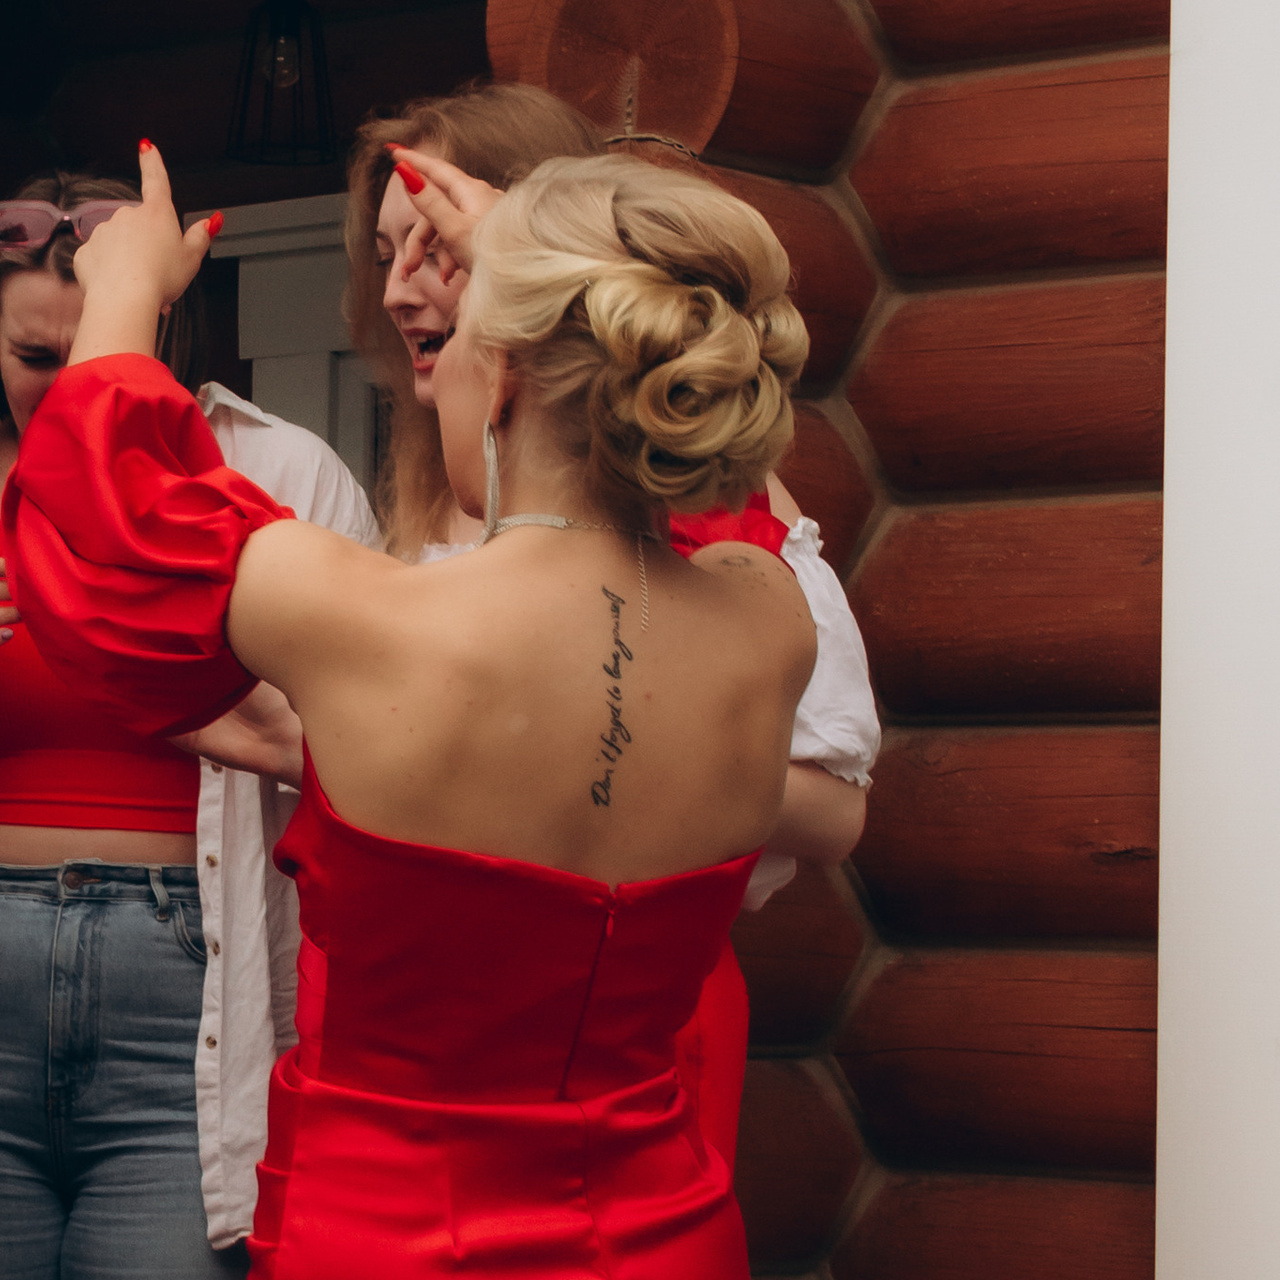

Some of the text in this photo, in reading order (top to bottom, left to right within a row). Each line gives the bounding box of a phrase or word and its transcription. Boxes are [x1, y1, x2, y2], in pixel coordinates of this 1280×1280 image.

[591, 585, 633, 807] Don't forget to love yourself
